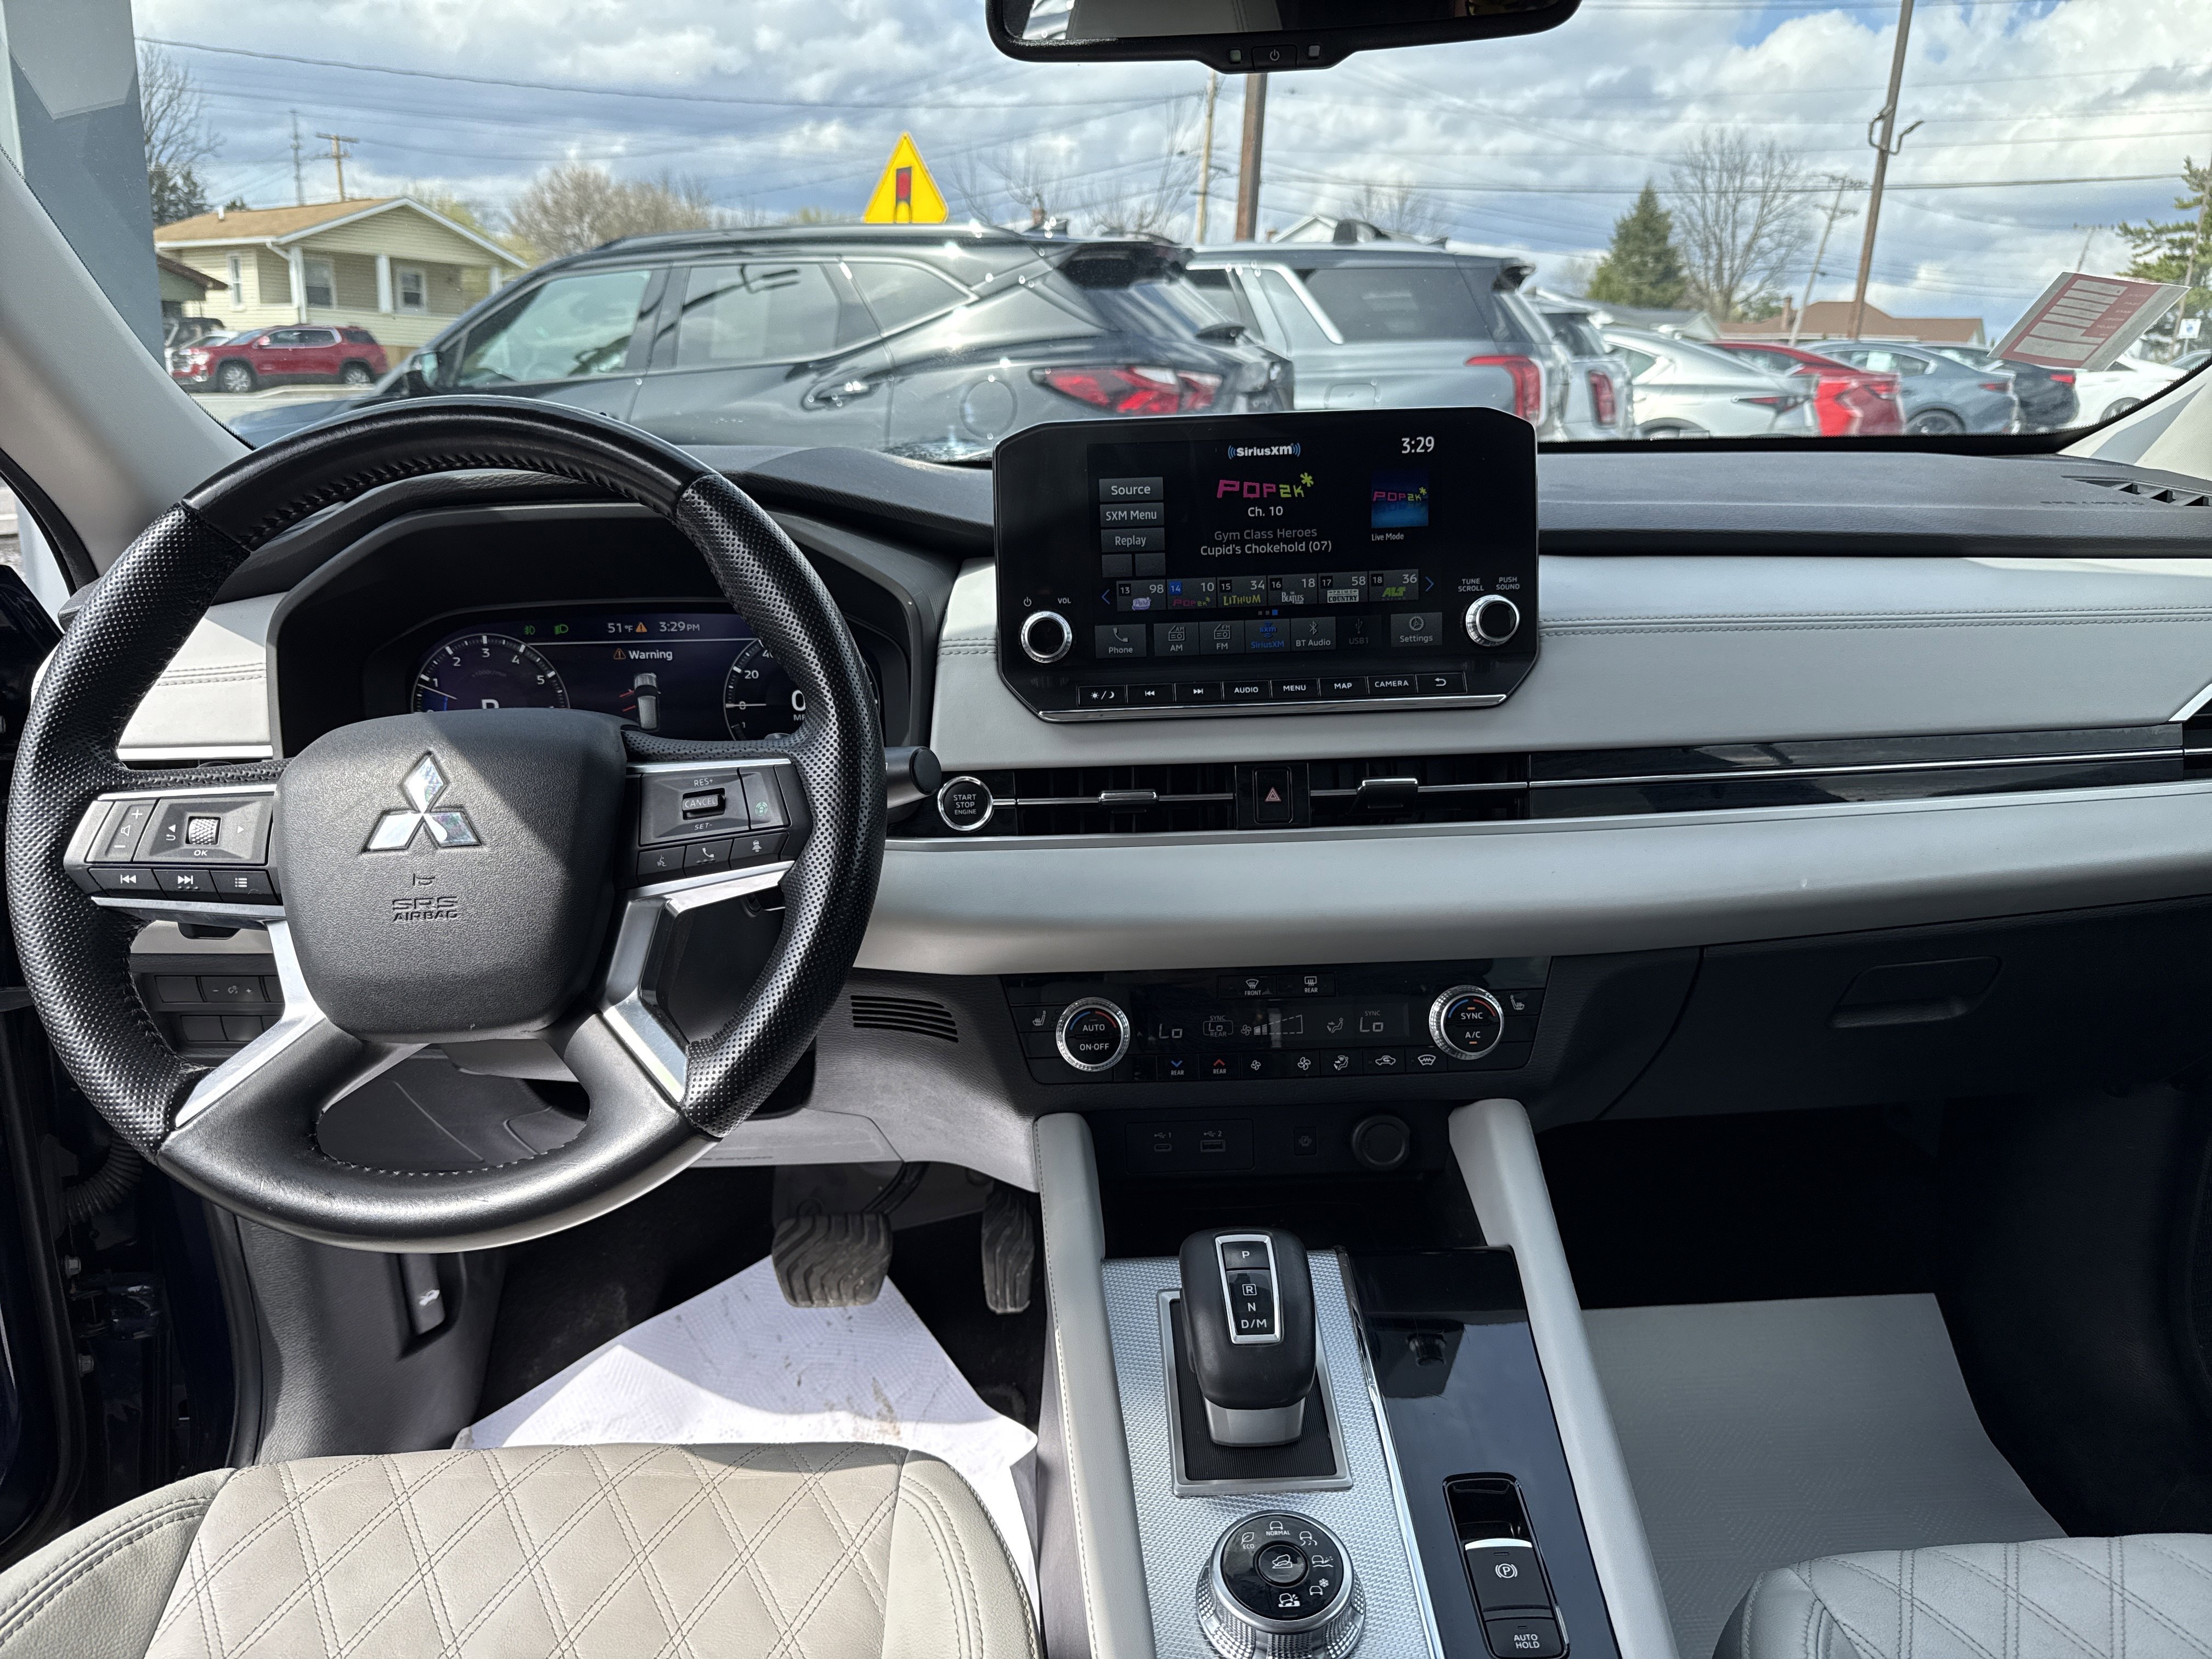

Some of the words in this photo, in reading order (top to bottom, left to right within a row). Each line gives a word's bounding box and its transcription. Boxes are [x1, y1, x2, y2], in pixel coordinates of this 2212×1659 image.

[1401, 436, 1435, 454] 3:29
[1111, 486, 1151, 495] Source
[1105, 511, 1127, 521] SXM
[1130, 510, 1157, 520] Menu
[1248, 506, 1265, 517] Ch.
[1269, 506, 1283, 516] 10
[1214, 531, 1240, 543] Gym
[1244, 529, 1273, 539] Class
[1277, 528, 1317, 539] Heroes
[1385, 532, 1404, 541] Mode
[1115, 535, 1147, 547] Replay
[1200, 544, 1242, 557] Cupid's
[1245, 541, 1306, 554] Chokehold
[1309, 540, 1332, 554] (07)
[1301, 578, 1316, 588] 18
[1351, 576, 1366, 586] 58
[1402, 574, 1417, 584] 36
[1149, 584, 1164, 594] 98
[1200, 582, 1215, 592] 10
[1250, 580, 1265, 590] 34
[1308, 638, 1331, 646] Audio
[1348, 637, 1369, 645] USB1
[1400, 634, 1434, 643] Settings
[1250, 640, 1285, 648] SiriusXM
[482, 648, 490, 658] 3
[628, 650, 673, 661] Warning
[452, 657, 461, 667] 2
[511, 656, 520, 665] 4
[537, 675, 545, 685] 5
[743, 670, 759, 680] 20
[432, 678, 438, 687] 1
[1334, 682, 1353, 690] MAP
[1374, 680, 1409, 688] CAMERA
[684, 797, 716, 809] CANCEL
[392, 895, 459, 911] SRS
[392, 910, 459, 922] AIRBAG
[1460, 1012, 1483, 1020] SYNC
[1082, 1024, 1105, 1032] AUTO
[1242, 1250, 1250, 1259] P
[1245, 1285, 1254, 1294] R
[1248, 1302, 1256, 1312] N
[1241, 1319, 1267, 1329] D/M
